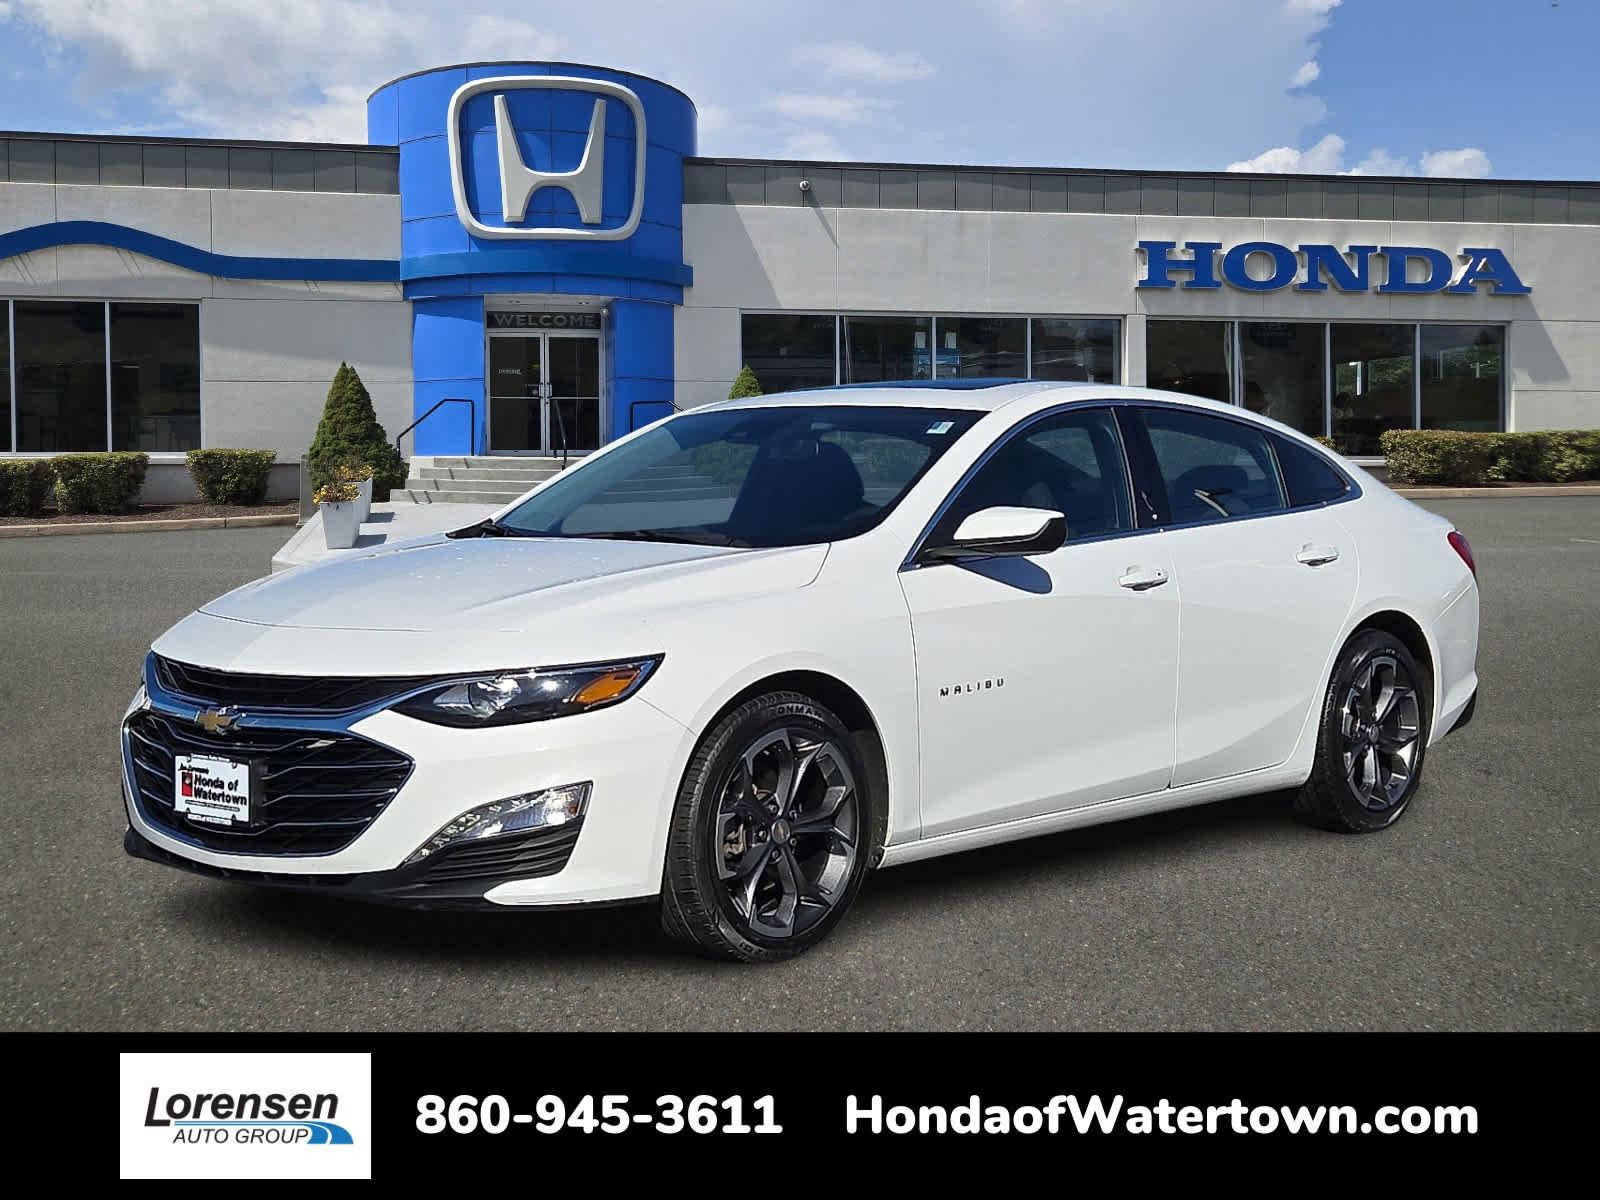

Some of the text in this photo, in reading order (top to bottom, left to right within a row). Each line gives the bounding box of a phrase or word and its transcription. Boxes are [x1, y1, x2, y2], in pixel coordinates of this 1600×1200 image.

[1137, 241, 1532, 294] HONDA
[494, 313, 596, 328] WELCOME
[939, 678, 1004, 697] MALIBU
[194, 774, 239, 792] Honda of
[194, 786, 247, 806] Watertown
